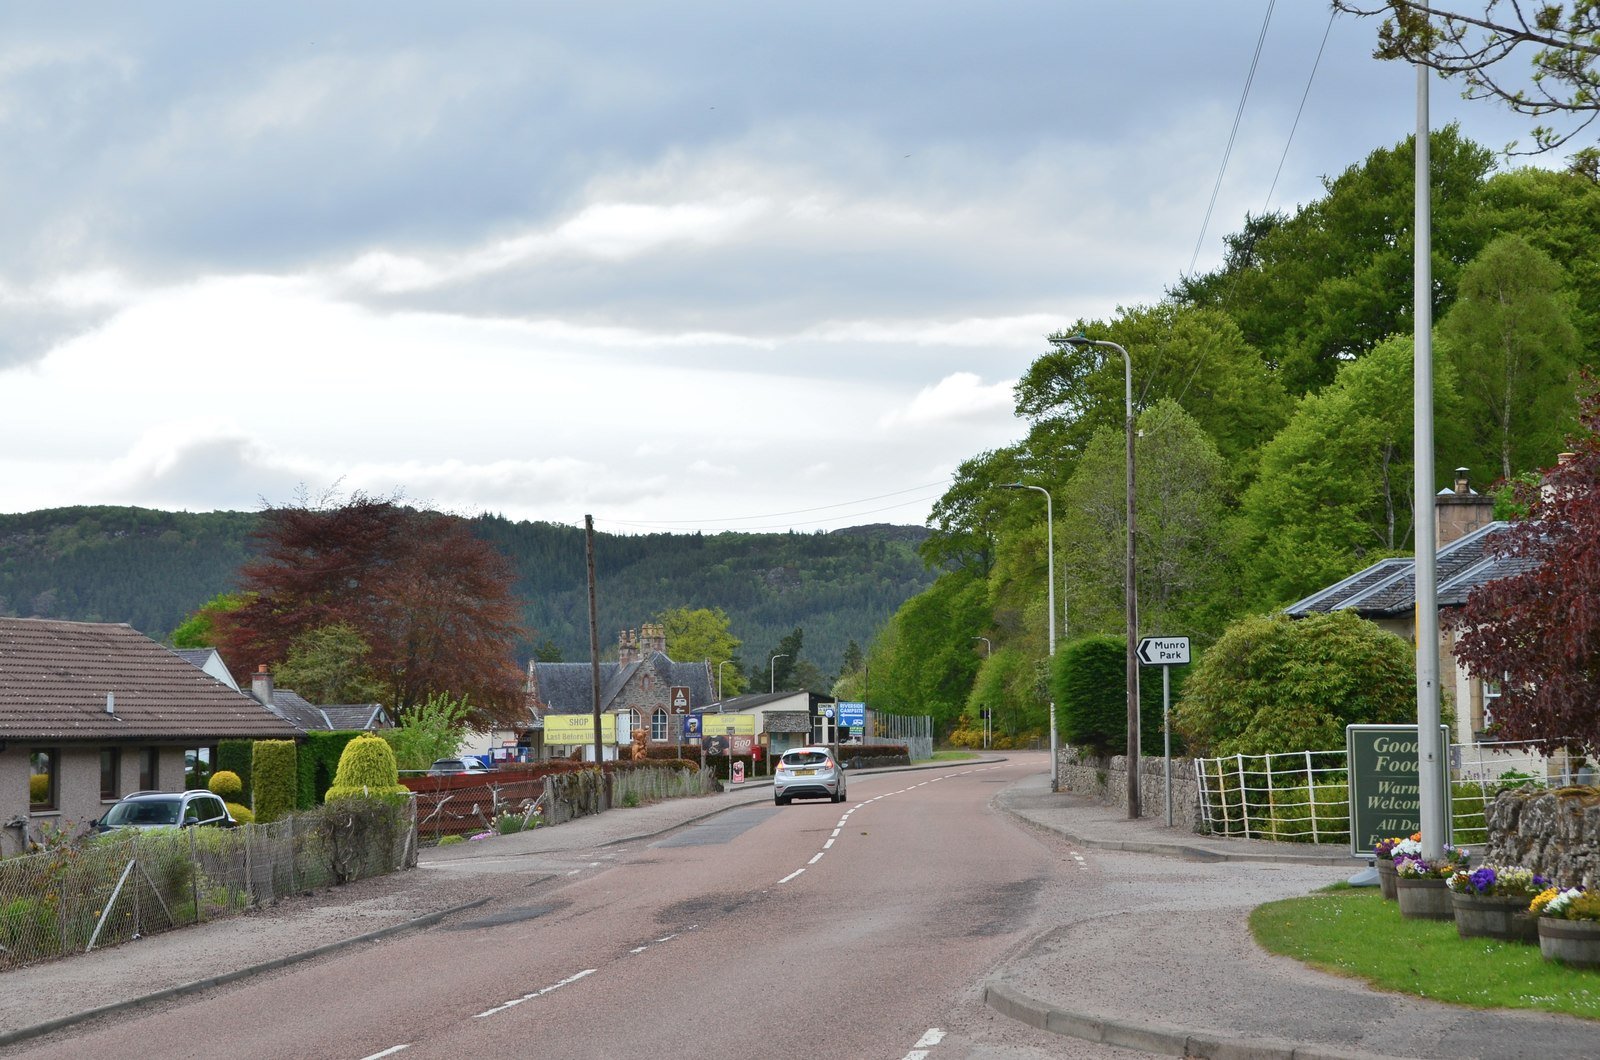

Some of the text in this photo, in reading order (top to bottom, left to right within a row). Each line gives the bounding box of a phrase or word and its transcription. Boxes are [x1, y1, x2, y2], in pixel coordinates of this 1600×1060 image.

[1154, 641, 1186, 649] Munro
[1160, 651, 1182, 659] Park
[569, 718, 589, 726] SHOP
[546, 732, 560, 740] Last
[562, 731, 584, 740] Before
[1368, 796, 1421, 810] Welcom
[1376, 819, 1421, 831] All Da
